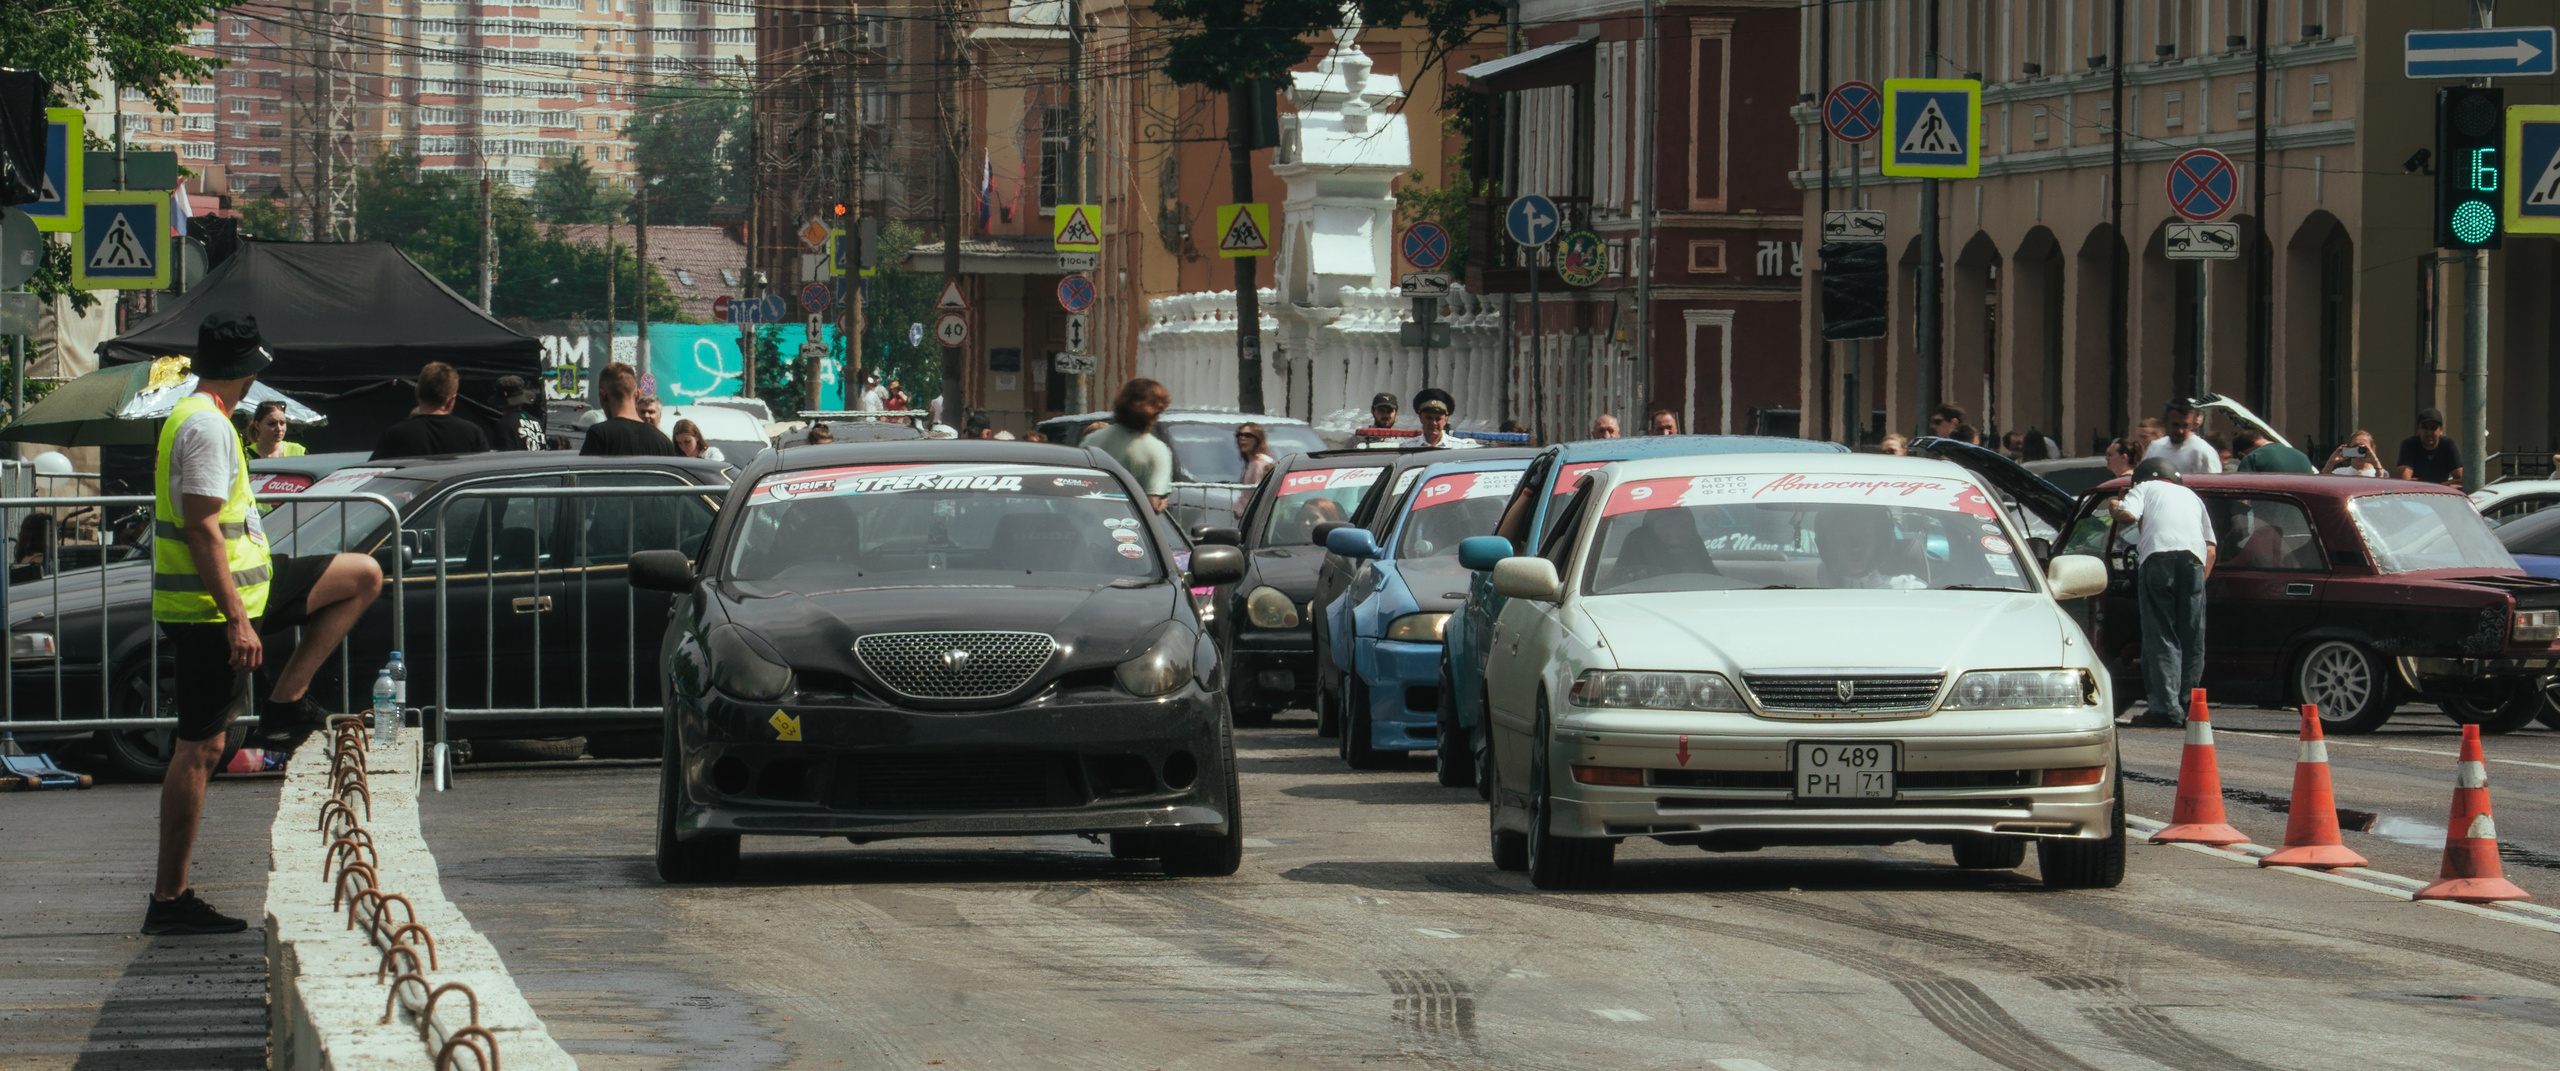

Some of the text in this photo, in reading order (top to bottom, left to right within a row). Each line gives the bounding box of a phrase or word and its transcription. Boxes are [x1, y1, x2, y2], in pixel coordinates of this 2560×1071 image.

[2472, 148, 2498, 191] 16
[943, 323, 964, 337] 40
[788, 479, 836, 491] DRIFT
[1288, 474, 1328, 487] 160
[1701, 475, 1747, 484] АВТО
[1752, 472, 1946, 499] Автострада
[1424, 483, 1452, 498] 19
[1630, 487, 1653, 500] 9
[775, 716, 796, 736] TOW
[1812, 747, 1879, 767] О 489
[1807, 773, 1884, 794] РН 71
[1865, 790, 1880, 798] RUS
